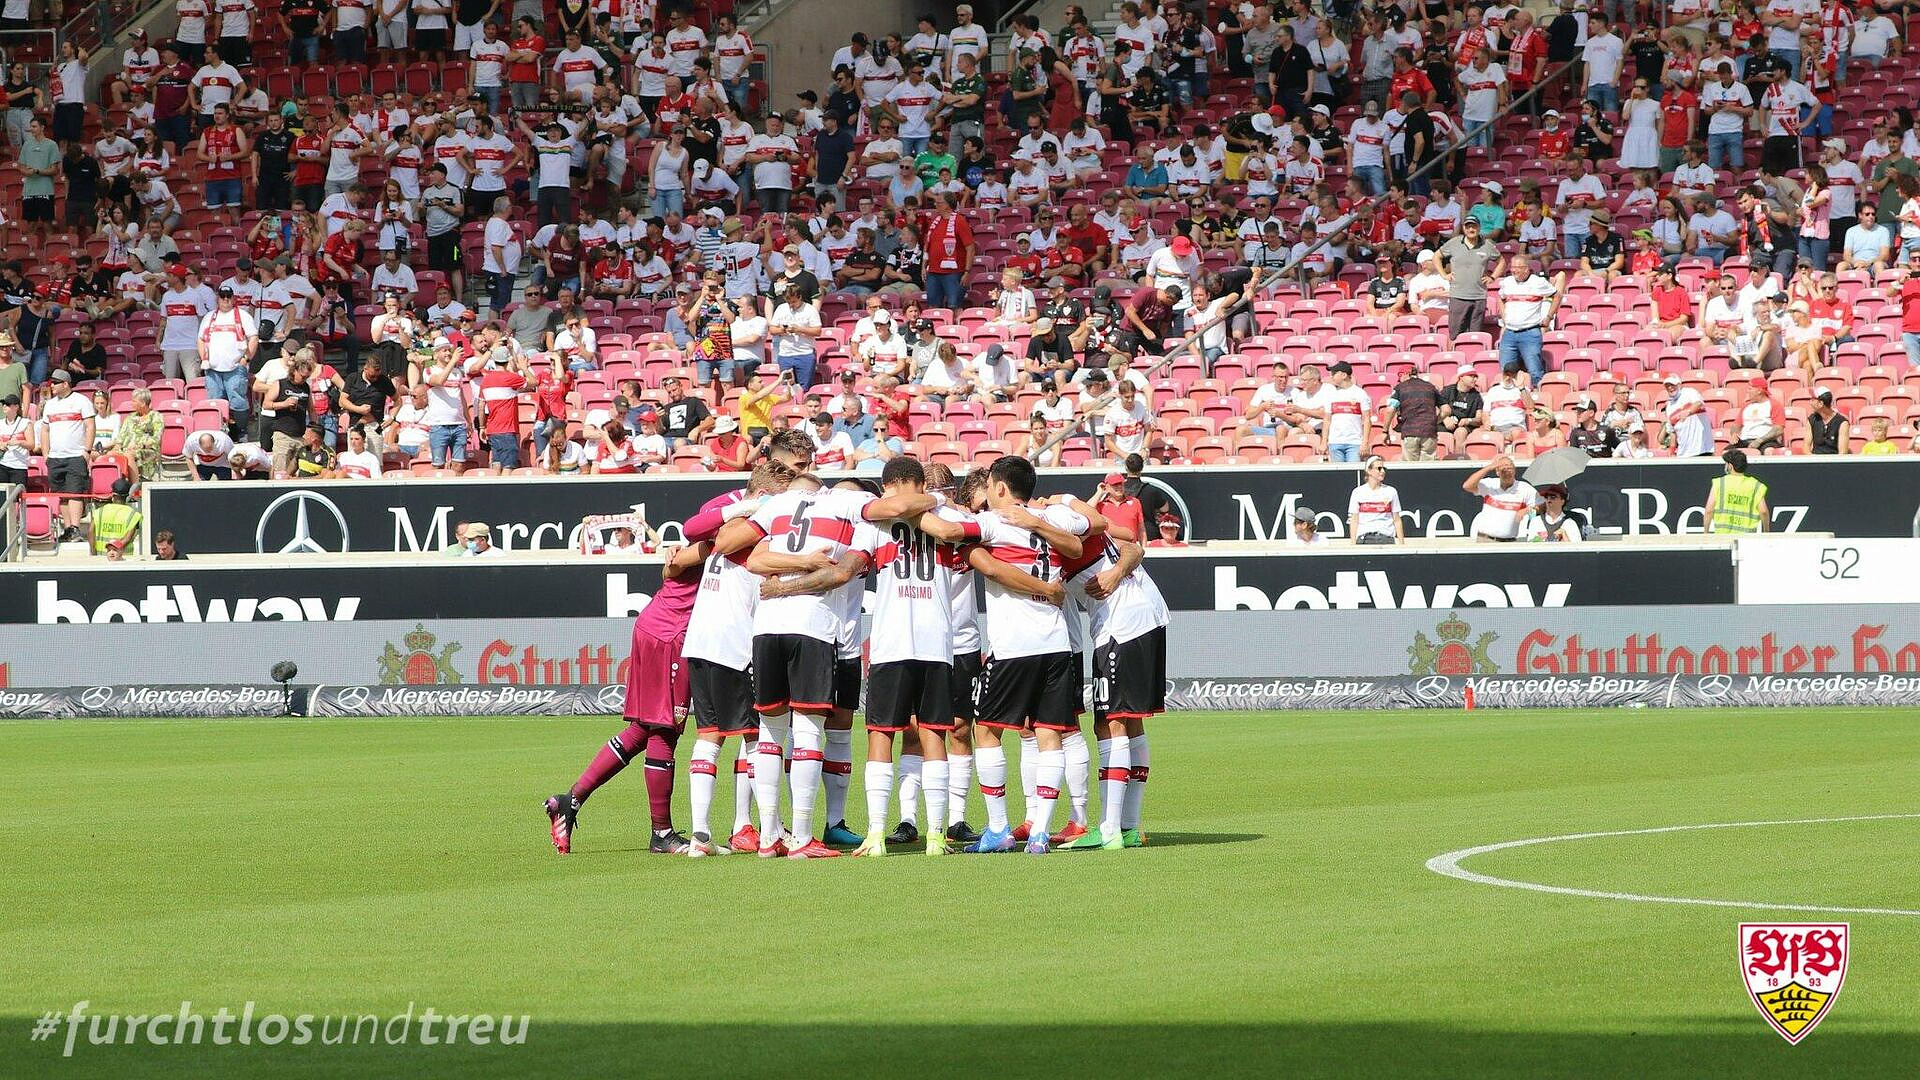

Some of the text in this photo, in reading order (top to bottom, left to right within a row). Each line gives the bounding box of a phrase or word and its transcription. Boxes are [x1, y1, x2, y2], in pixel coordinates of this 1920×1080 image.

[787, 501, 815, 552] 5
[891, 522, 935, 582] 30
[1029, 532, 1050, 583] 3
[1820, 547, 1860, 580] 52
[380, 687, 556, 704] Mercedes-Benz
[1093, 675, 1110, 703] 20
[1187, 679, 1374, 697] Mercedes-Benz
[1462, 675, 1650, 694] Mercedes-Benz
[0, 690, 43, 706] enz
[692, 762, 710, 770] AKO
